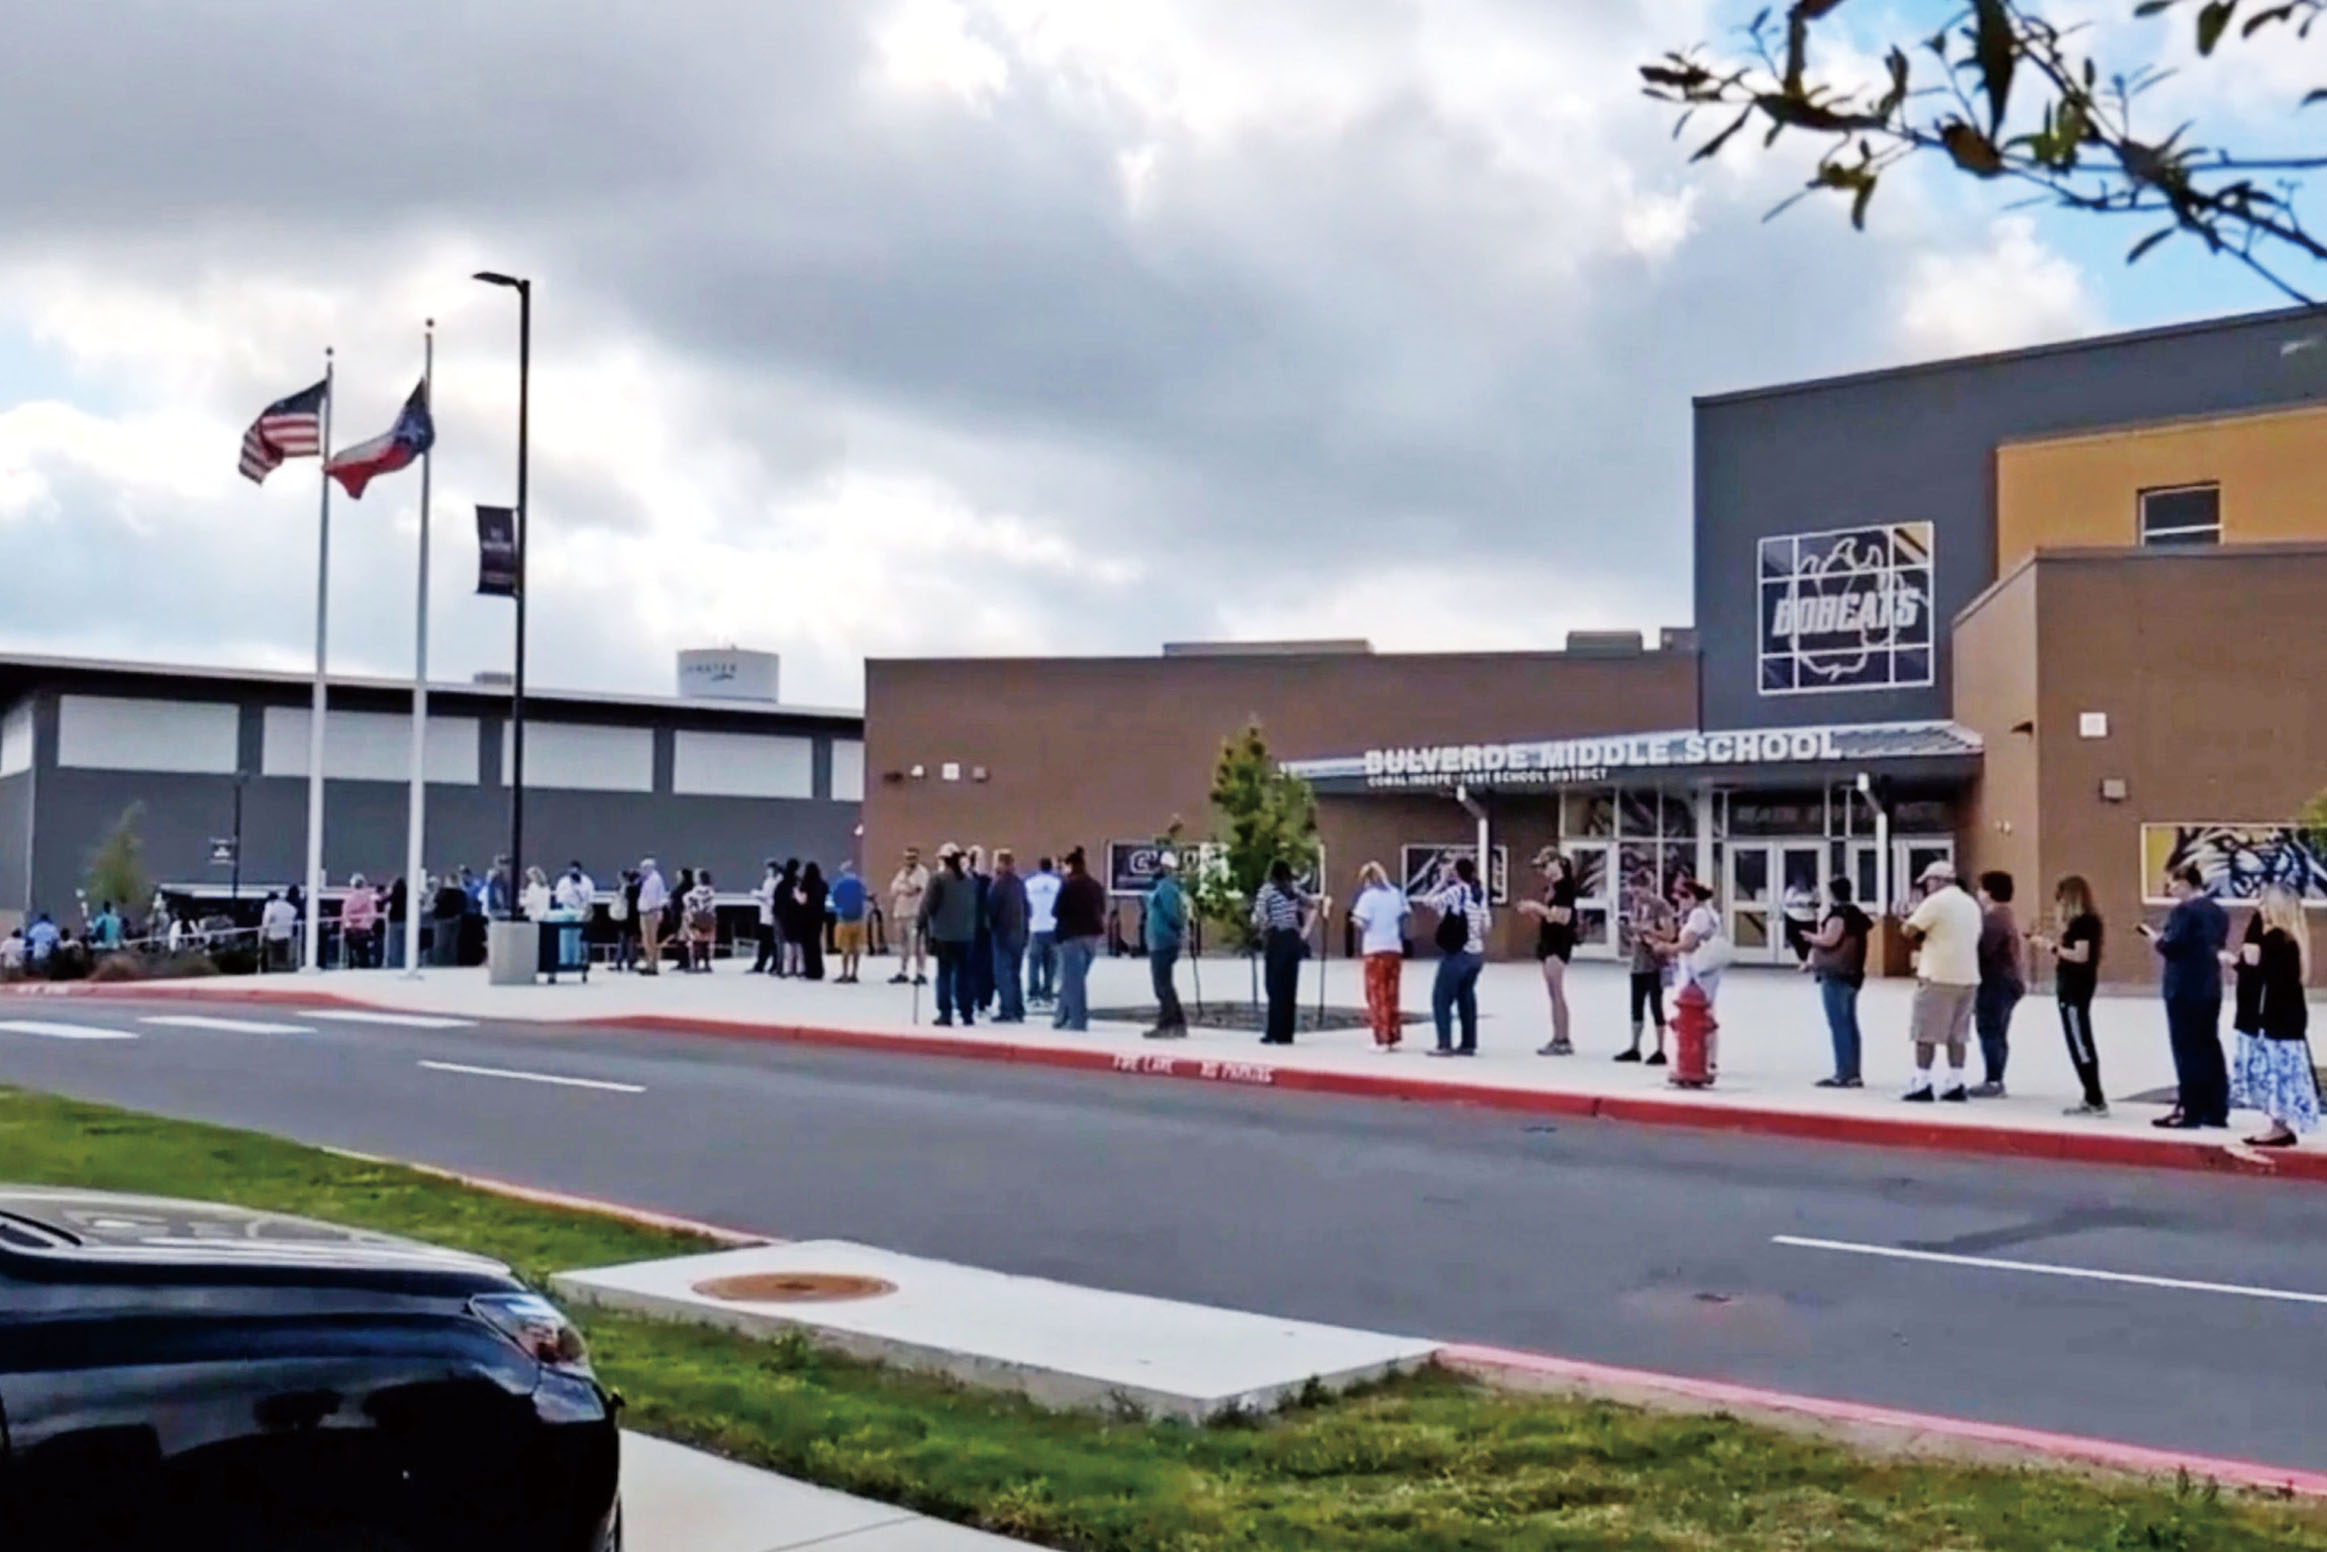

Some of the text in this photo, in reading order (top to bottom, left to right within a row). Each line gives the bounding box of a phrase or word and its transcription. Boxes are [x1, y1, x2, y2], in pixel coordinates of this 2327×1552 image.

[1772, 587, 1920, 637] BOBCATS
[1365, 731, 1841, 775] BULVERDE MIDDLE SCHOOL
[1493, 771, 1545, 783] SCHOOL
[1548, 767, 1607, 783] DISTRICT
